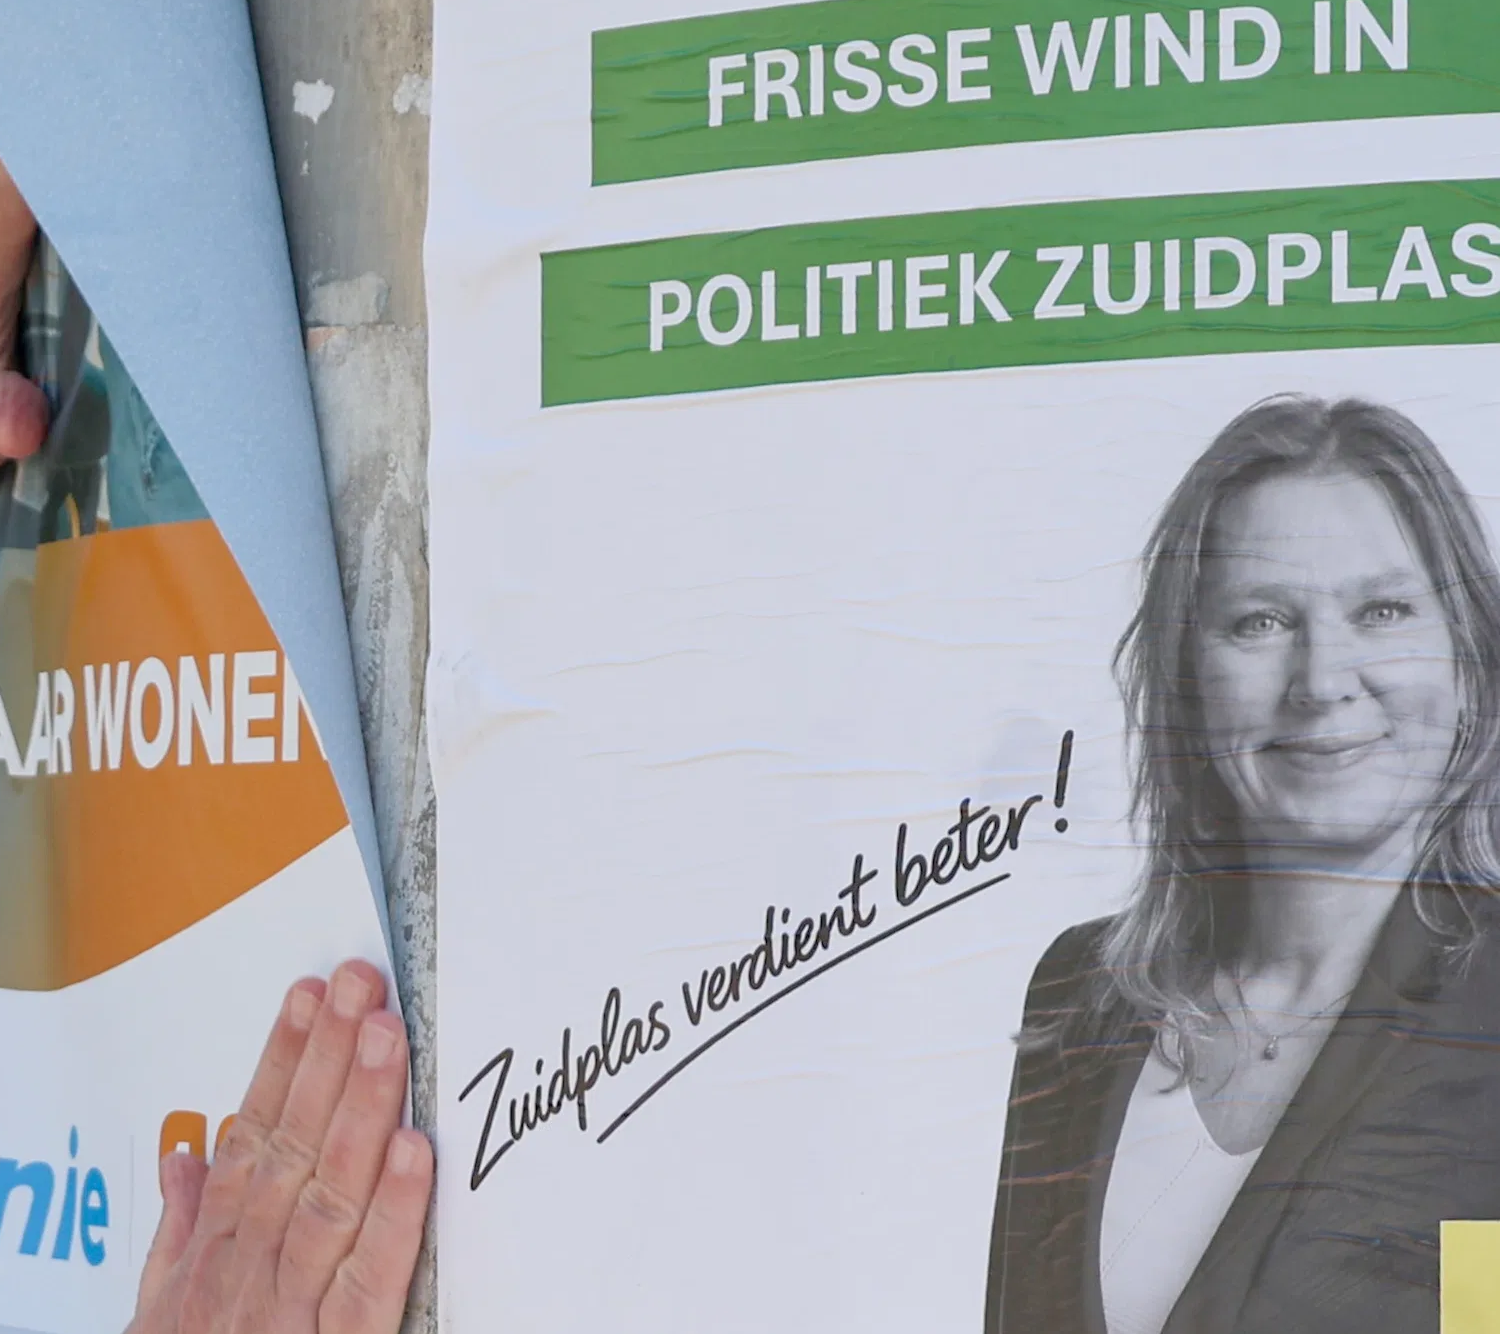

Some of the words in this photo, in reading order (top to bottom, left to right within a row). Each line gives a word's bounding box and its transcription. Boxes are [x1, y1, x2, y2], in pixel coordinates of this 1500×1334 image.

[708, 28, 992, 127] FRISSE
[1014, 5, 1281, 96] WIND
[648, 247, 1013, 353] POLITIEK
[459, 987, 671, 1191] Zuidplas
[682, 854, 879, 1027] verdient
[893, 729, 1073, 907] beter!
